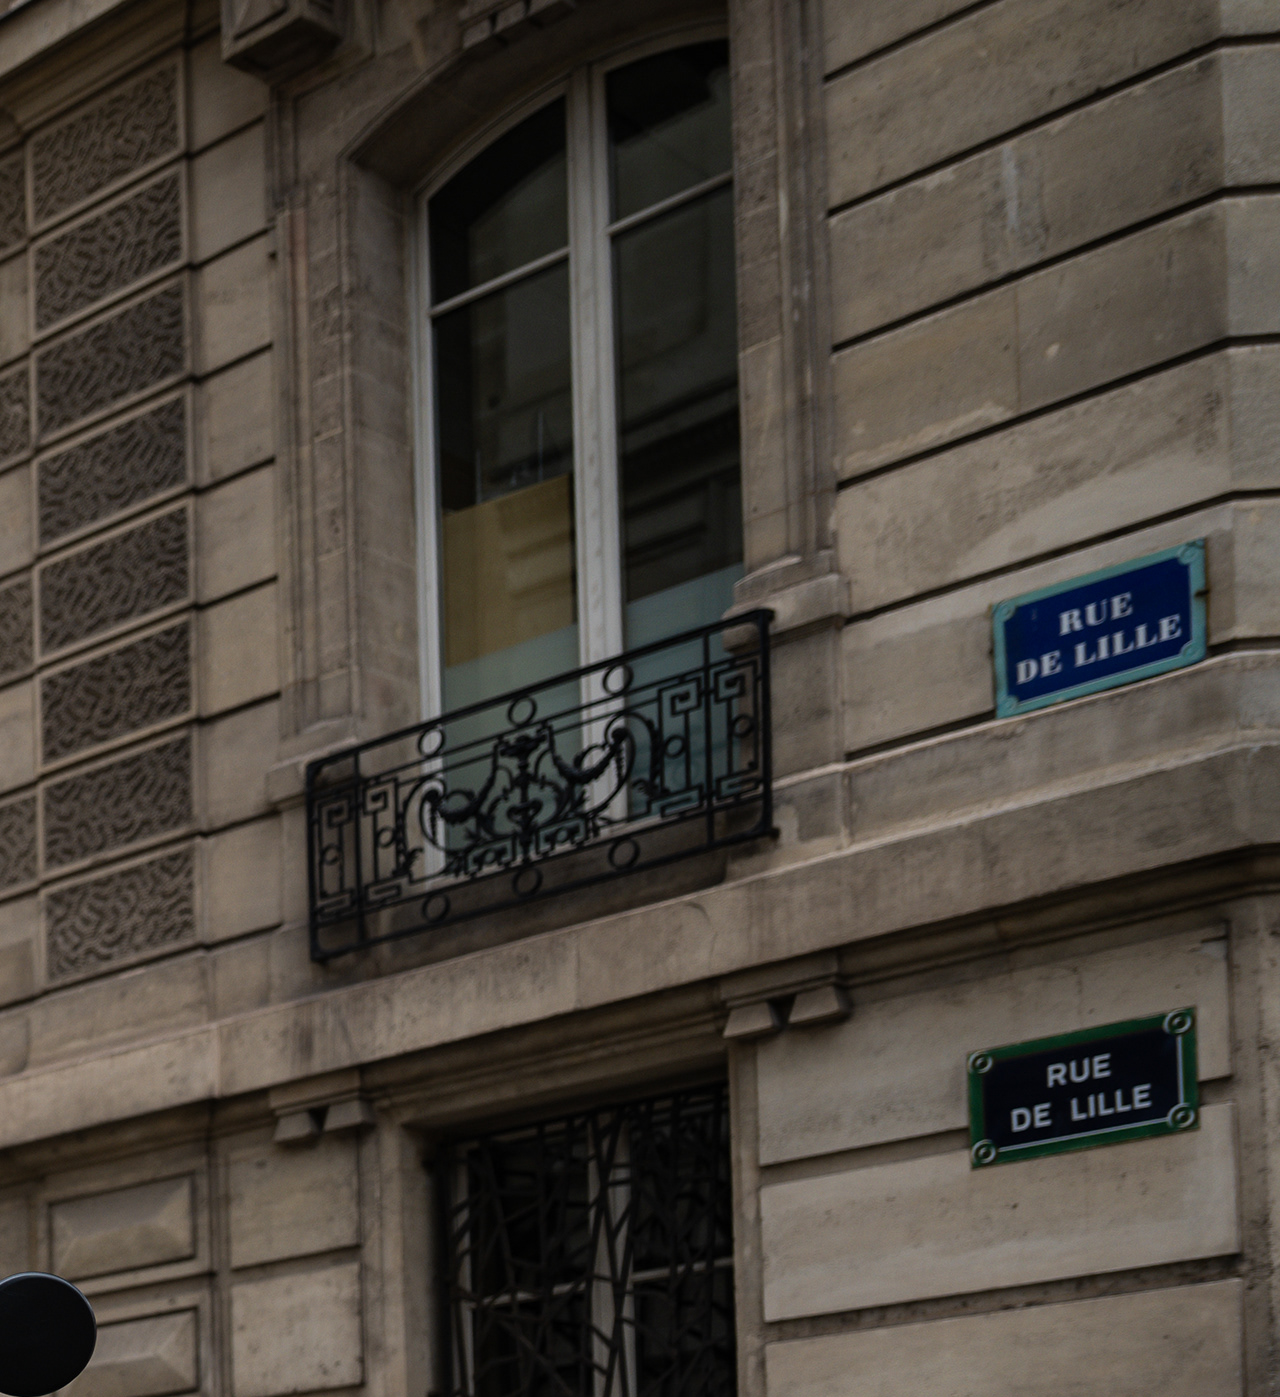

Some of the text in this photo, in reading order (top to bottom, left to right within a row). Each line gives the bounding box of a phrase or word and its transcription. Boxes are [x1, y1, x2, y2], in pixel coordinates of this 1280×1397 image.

[1059, 591, 1133, 636] RUE
[1016, 613, 1183, 685] DE LILLE
[1046, 1053, 1112, 1088] RUE
[1010, 1083, 1153, 1133] DE LILLE
